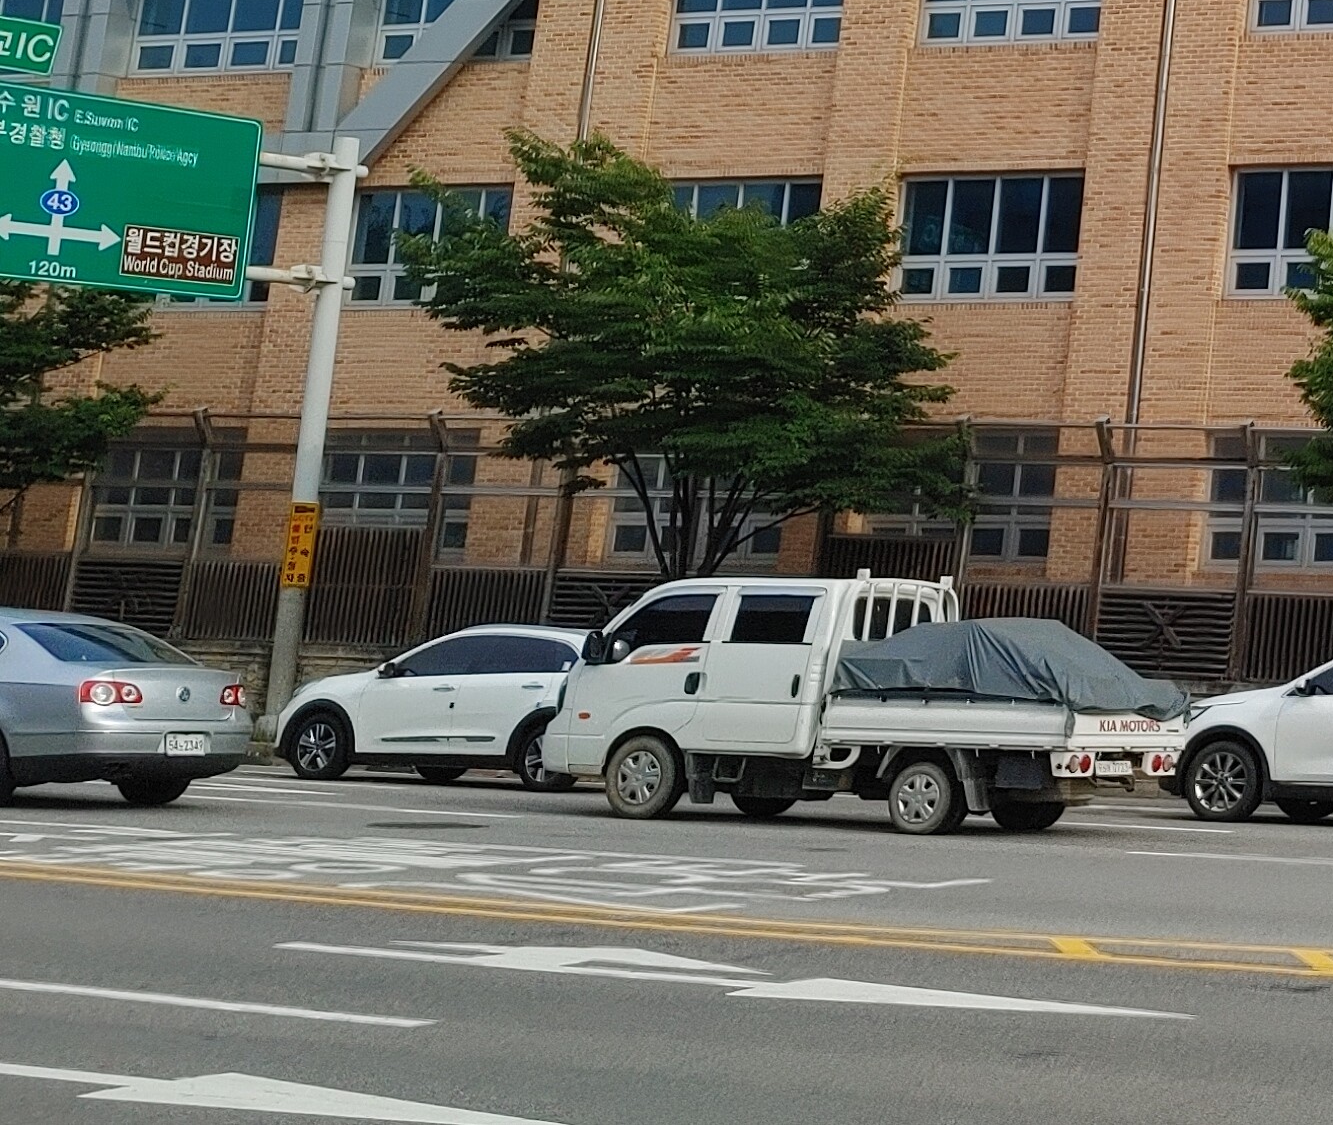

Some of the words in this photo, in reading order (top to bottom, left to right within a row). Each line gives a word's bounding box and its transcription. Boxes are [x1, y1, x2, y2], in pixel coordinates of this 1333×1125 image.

[46, 193, 73, 212] 43
[126, 227, 238, 263] 월드컵경기장
[28, 260, 77, 279] 120m
[123, 254, 158, 274] World
[159, 258, 183, 279] Cup
[185, 260, 234, 281] Stadium
[1099, 719, 1117, 733] KIA
[1119, 719, 1161, 733] MOTORS
